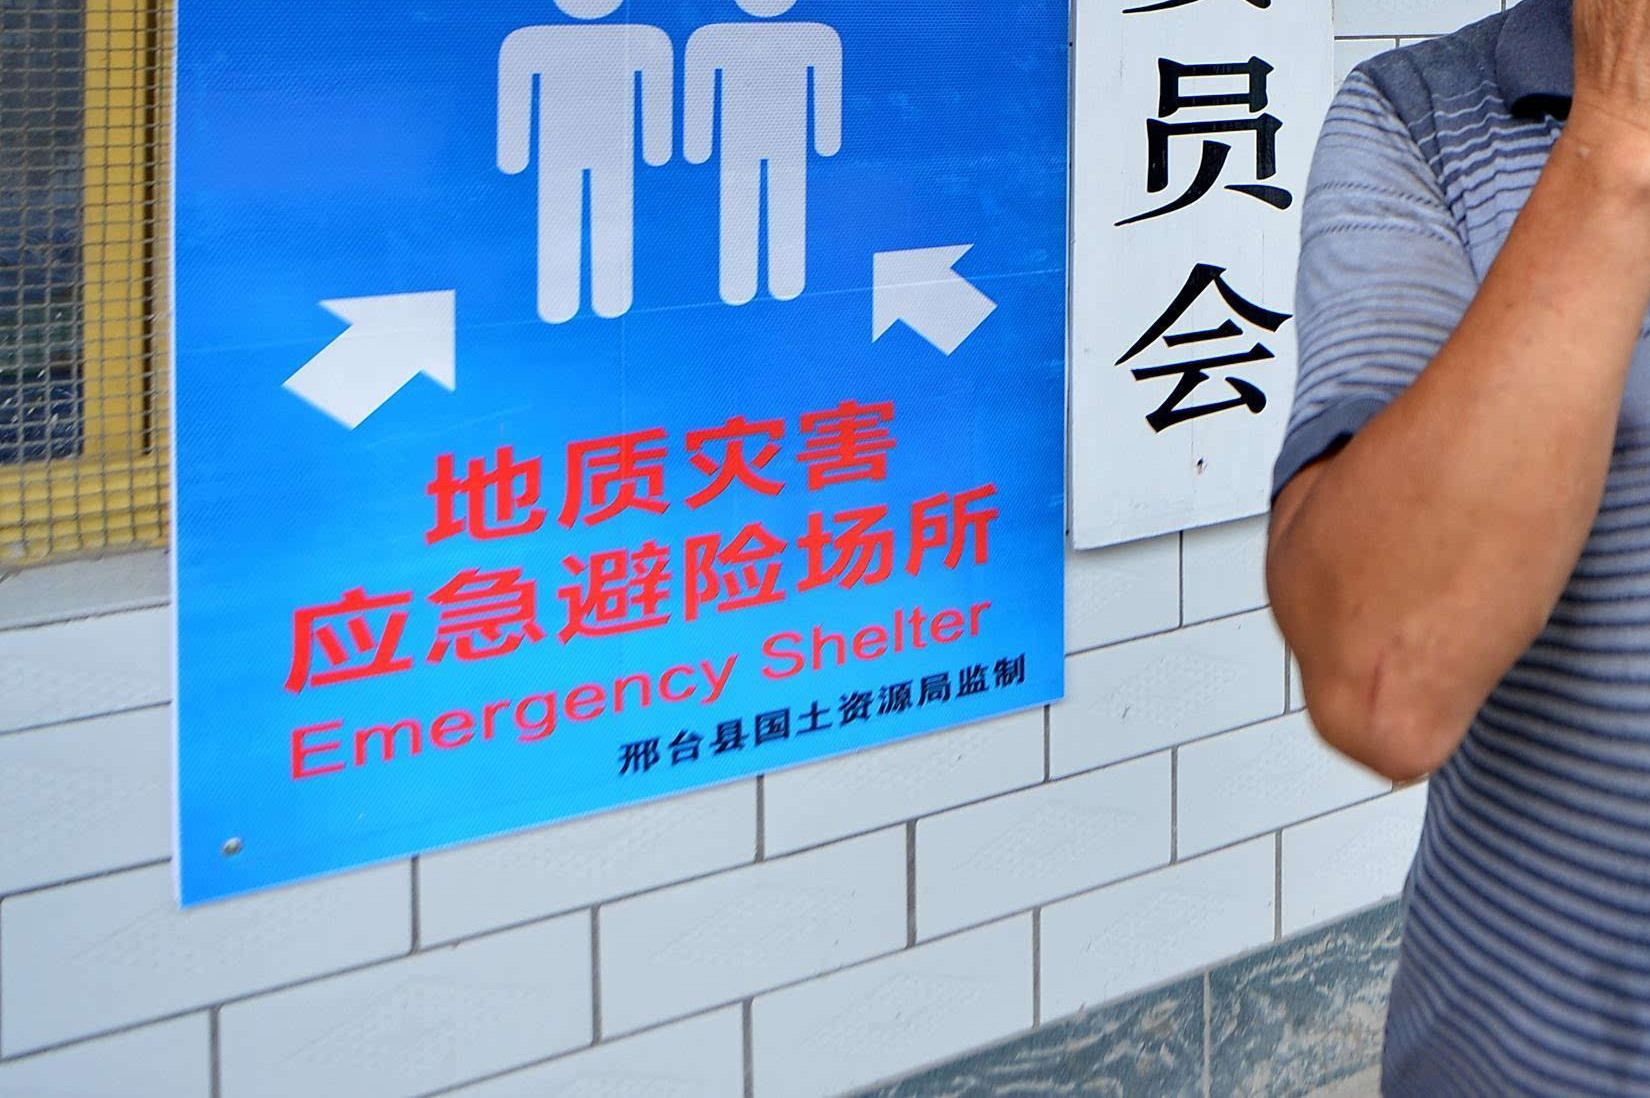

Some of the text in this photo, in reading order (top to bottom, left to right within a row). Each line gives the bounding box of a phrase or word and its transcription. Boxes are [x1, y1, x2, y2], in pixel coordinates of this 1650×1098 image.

[423, 399, 897, 547] 地质灾害
[284, 482, 1000, 695] 应急避险场所
[289, 599, 992, 781] Emergency Shelter
[619, 652, 1026, 775] 邢台县国土资源局监制
